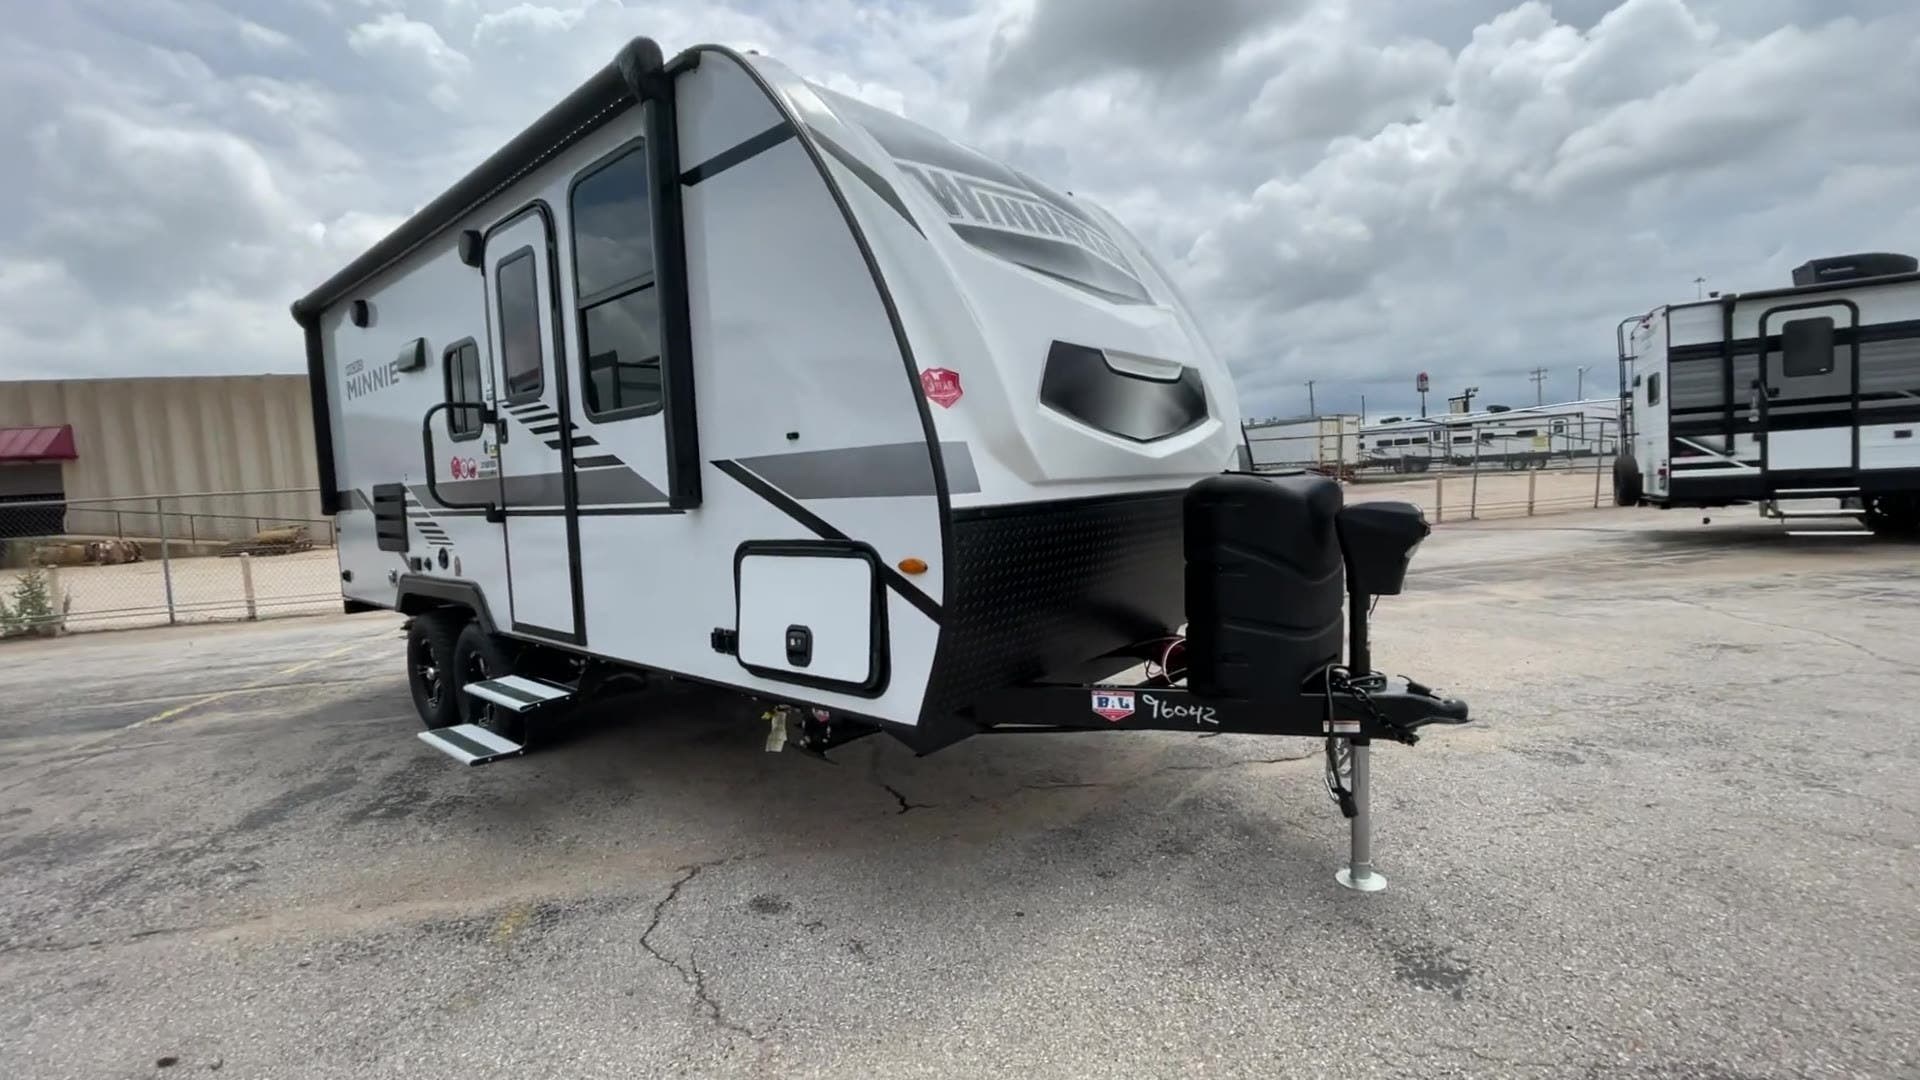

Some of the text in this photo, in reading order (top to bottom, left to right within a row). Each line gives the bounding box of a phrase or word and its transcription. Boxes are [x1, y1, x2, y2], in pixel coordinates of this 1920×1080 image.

[894, 160, 1139, 279] WINNE
[346, 360, 400, 401] MINNIE
[1142, 694, 1220, 725] 96042
